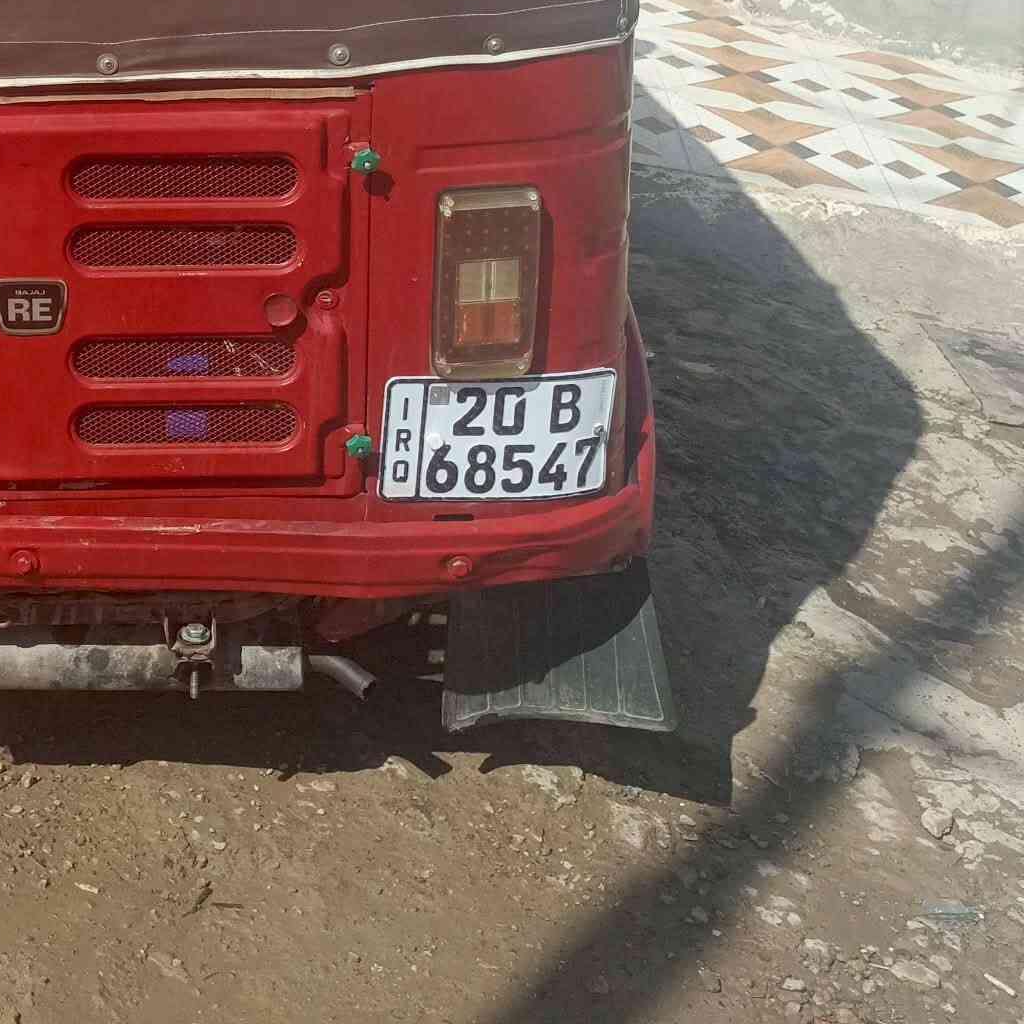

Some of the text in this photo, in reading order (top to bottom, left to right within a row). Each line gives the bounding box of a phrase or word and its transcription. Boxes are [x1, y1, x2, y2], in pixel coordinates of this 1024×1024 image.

[7, 298, 52, 321] RE
[452, 384, 581, 436] 20 B
[392, 397, 412, 483] IRQ
[425, 436, 603, 494] 68547
